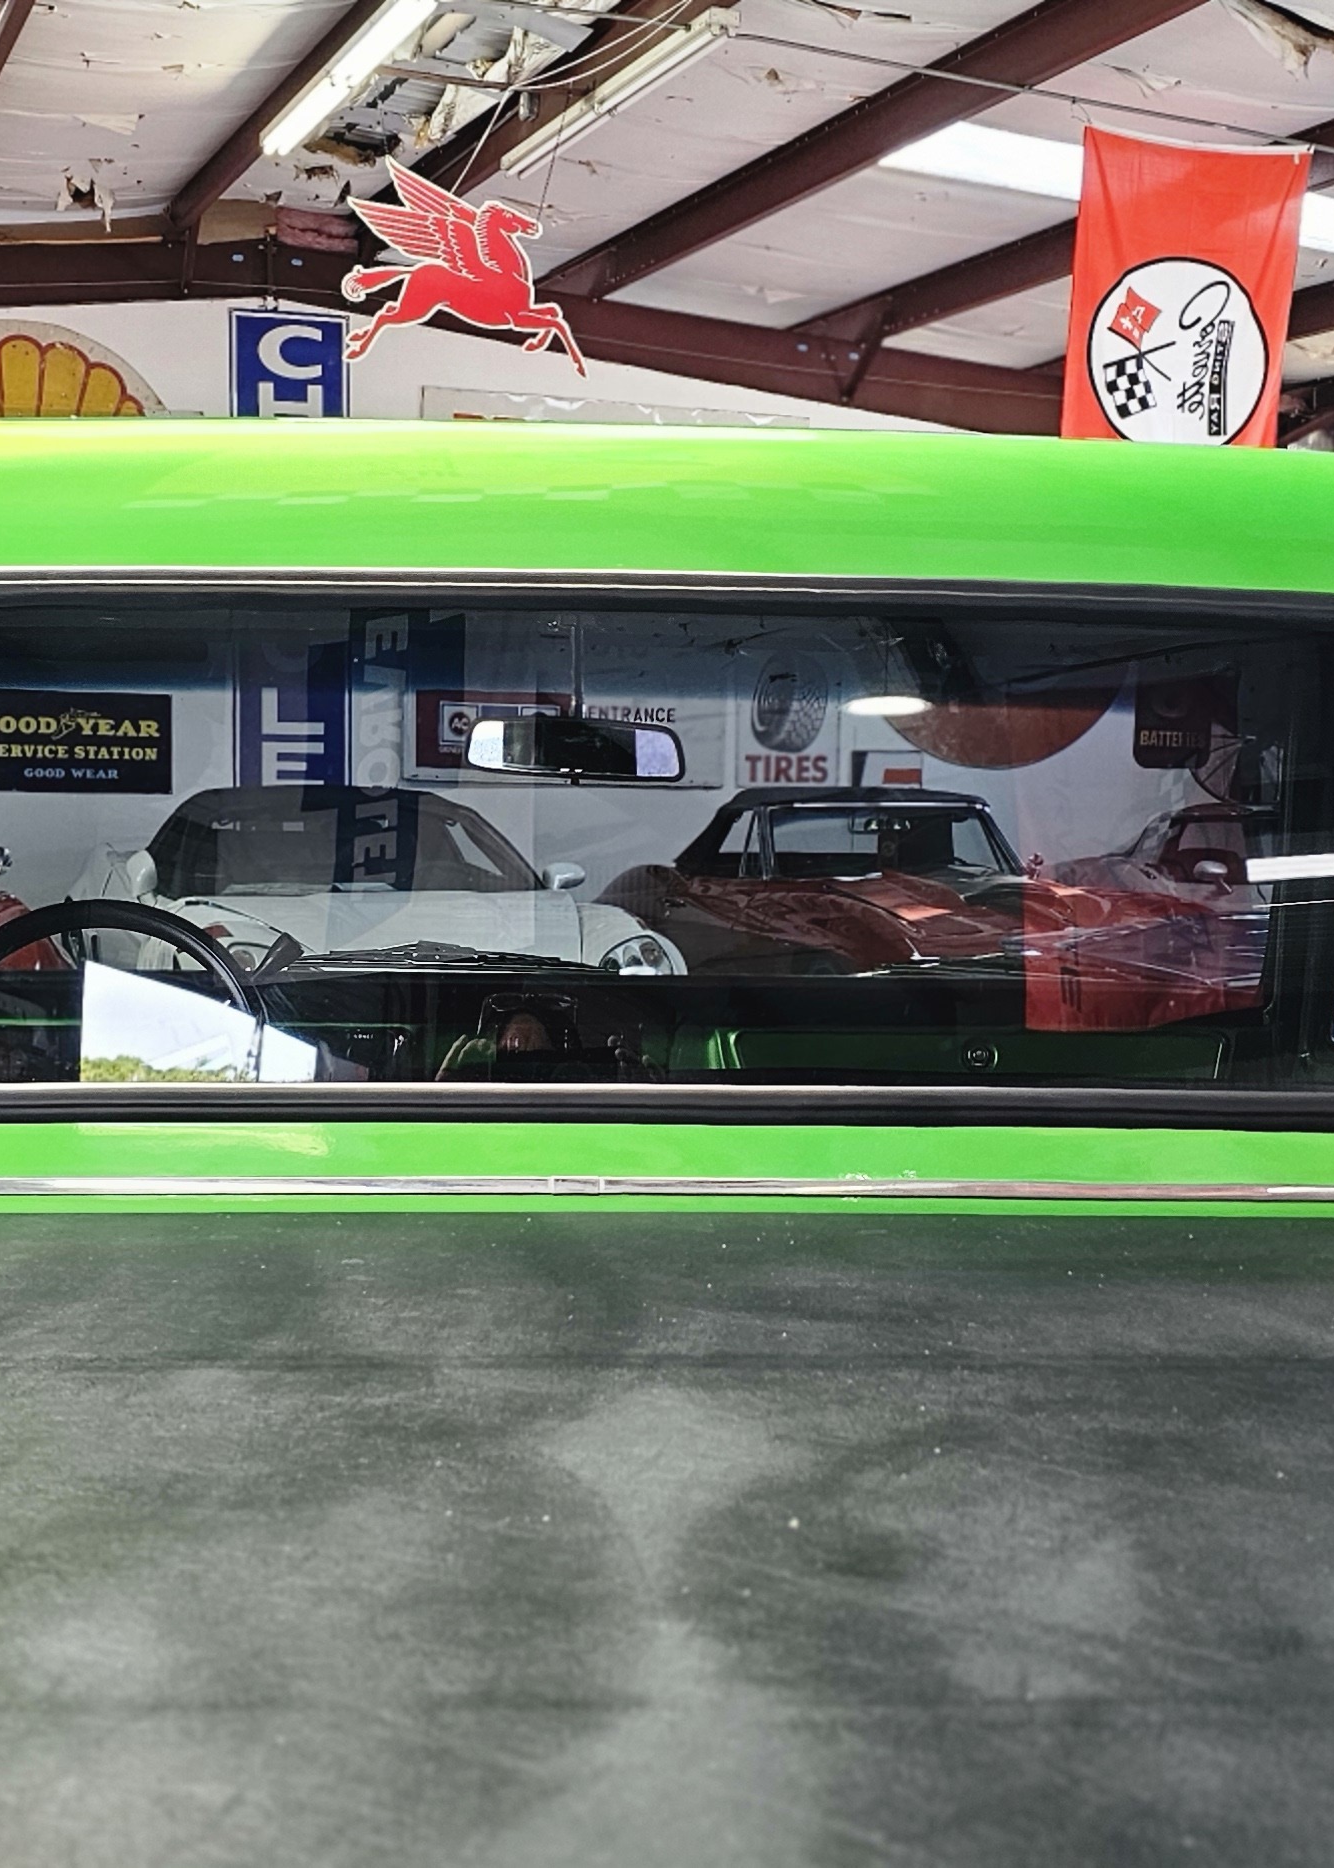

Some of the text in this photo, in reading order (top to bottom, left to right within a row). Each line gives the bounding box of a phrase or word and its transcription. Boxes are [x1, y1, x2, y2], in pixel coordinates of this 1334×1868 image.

[587, 704, 677, 723] ENTRANCE
[77, 717, 160, 737] YEAR
[74, 745, 158, 761] STATION
[23, 767, 119, 779] GOOD WEAR
[744, 753, 829, 784] TIRES
